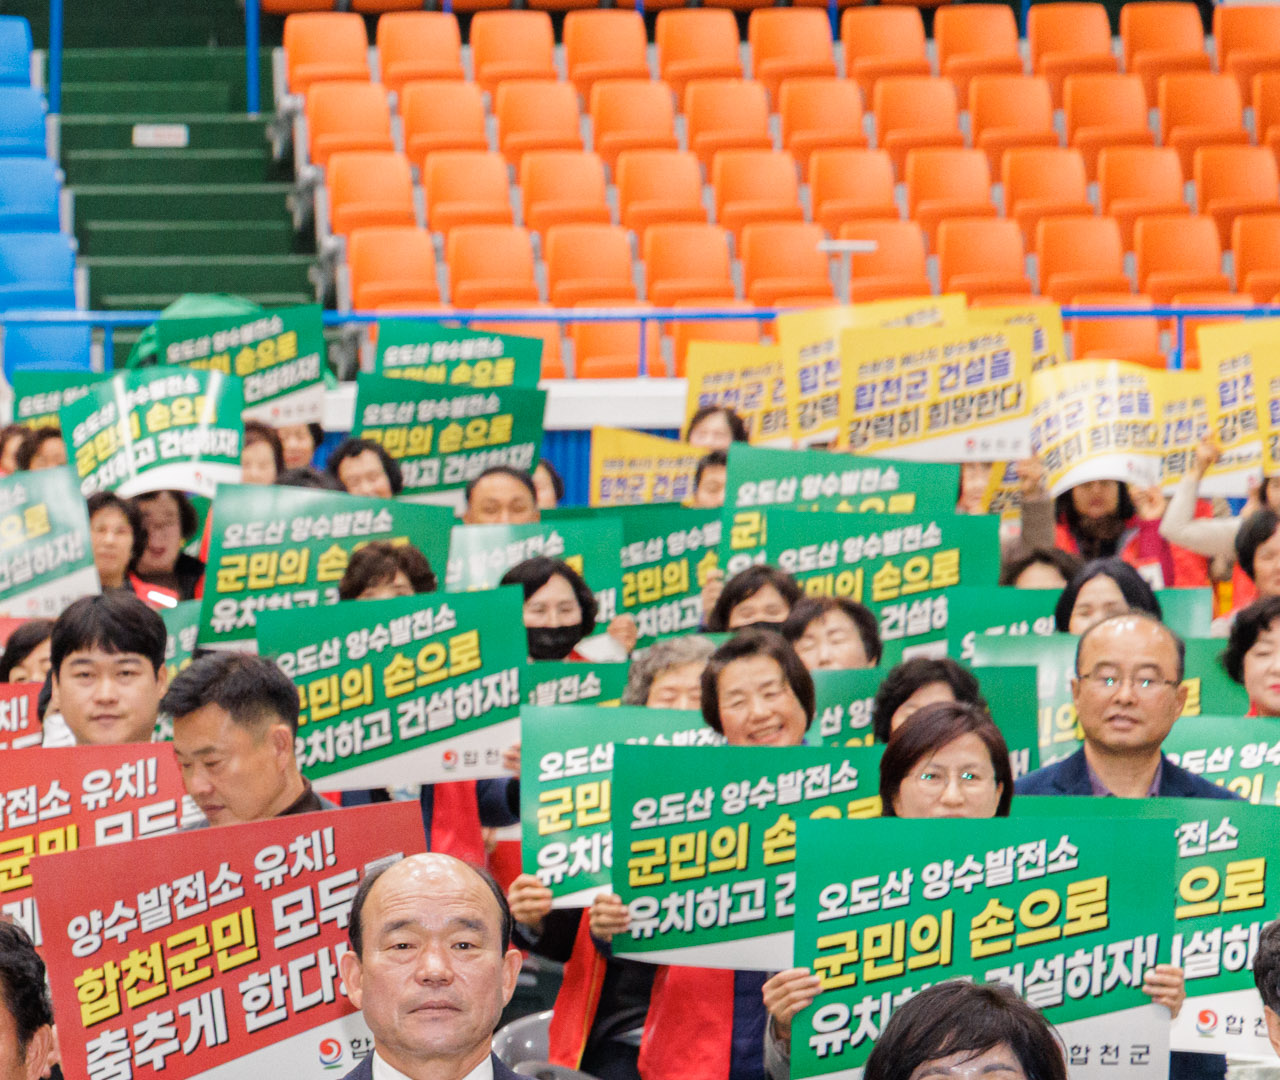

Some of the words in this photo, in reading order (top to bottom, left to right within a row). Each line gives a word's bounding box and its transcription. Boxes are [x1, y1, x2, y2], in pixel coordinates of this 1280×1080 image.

[939, 349, 1012, 392] 건설을
[438, 413, 514, 455] 손으로
[736, 480, 798, 507] 오도산
[800, 463, 900, 498] 양수발전소
[222, 519, 286, 550] 오도산
[289, 507, 394, 540] 양수발전소
[777, 542, 839, 575] 오도산
[842, 521, 942, 565] 양수발전소
[215, 546, 311, 594] 군민의
[871, 548, 961, 602] 손으로
[275, 643, 341, 680] 오도산
[344, 603, 457, 661] 양수발전소
[383, 629, 482, 698] 손으로
[397, 667, 520, 740] 건설하자!
[80, 757, 159, 808] 유치!
[538, 741, 614, 783] 오도산
[629, 786, 714, 830] 오도산
[720, 758, 860, 816] 양수발전소
[627, 822, 750, 888] 군민의
[816, 867, 914, 923] 오도산
[921, 834, 1080, 901] 양수발전소
[66, 861, 245, 959] 양수발전소
[253, 827, 338, 888] 유치!
[627, 876, 766, 940] 유치하고
[813, 908, 953, 992] 군민의
[968, 875, 1109, 960] 손으로
[73, 906, 260, 1029] 합천군민
[1069, 1043, 1152, 1067] 합천군
